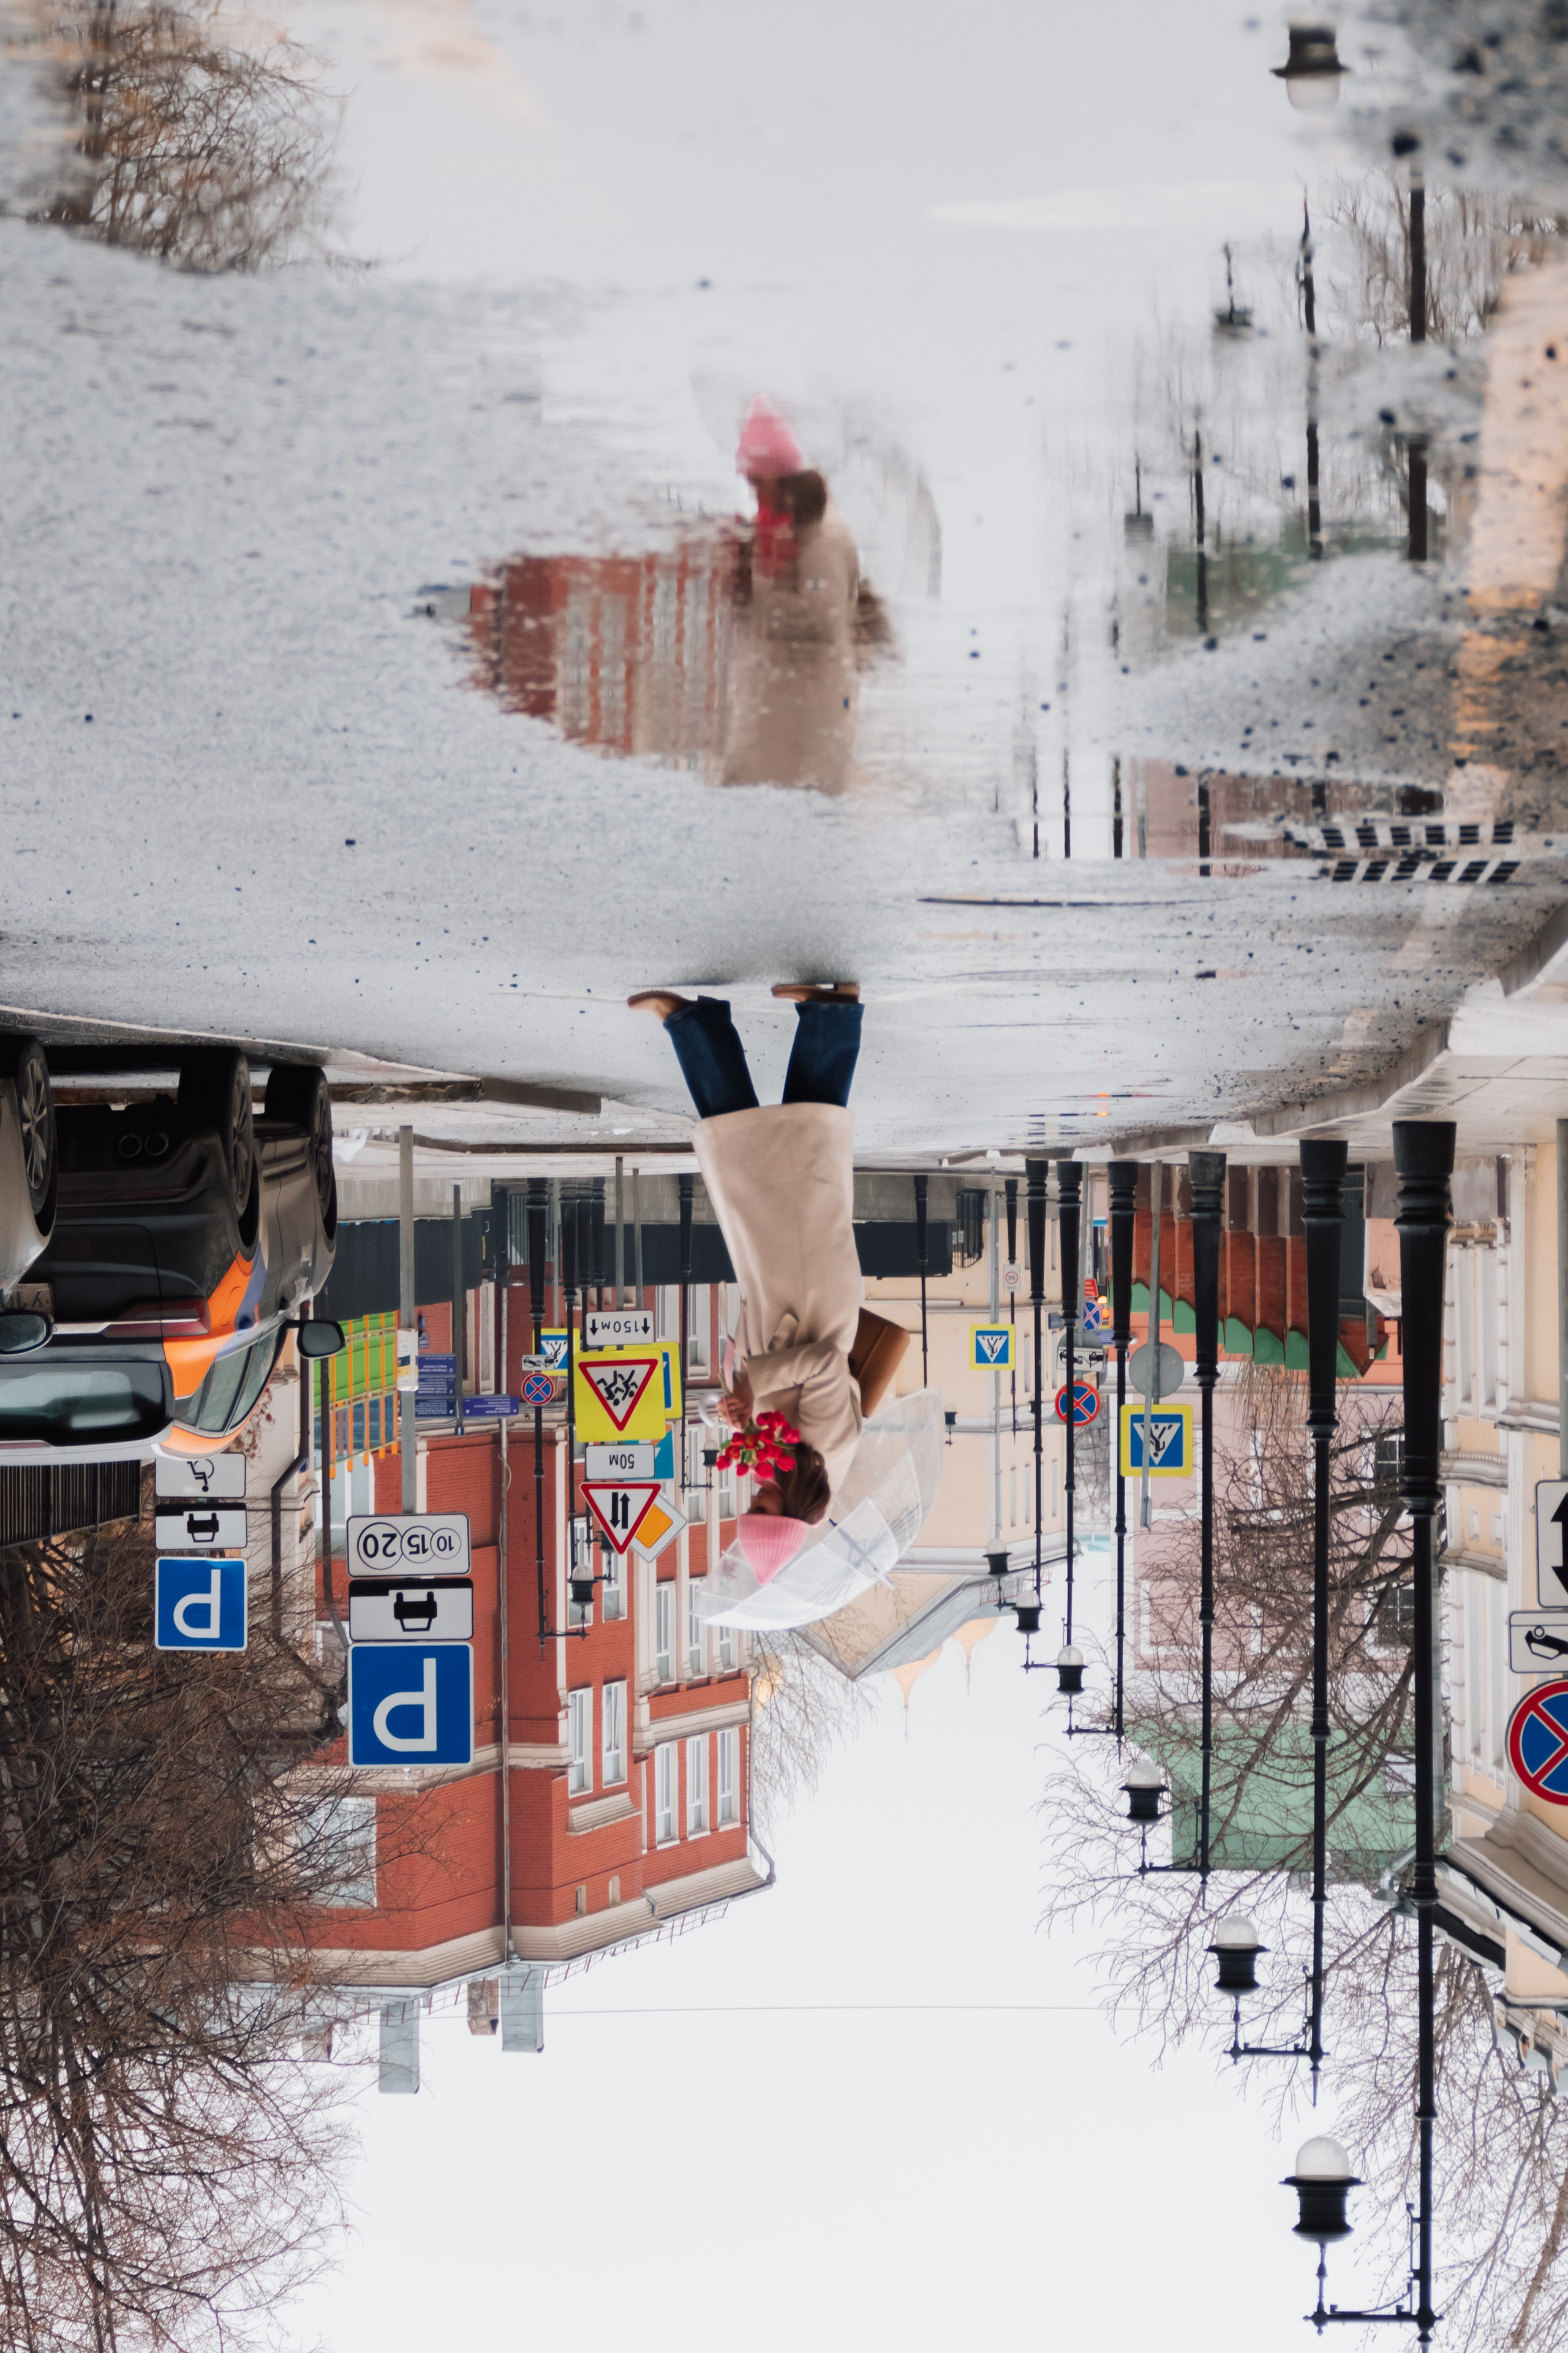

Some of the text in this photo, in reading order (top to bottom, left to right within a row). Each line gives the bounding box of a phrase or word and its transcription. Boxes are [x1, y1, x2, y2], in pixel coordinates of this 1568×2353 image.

[362, 1533, 454, 1558] 10 15 20
[173, 1569, 221, 1638] P
[374, 1658, 437, 1751] P
